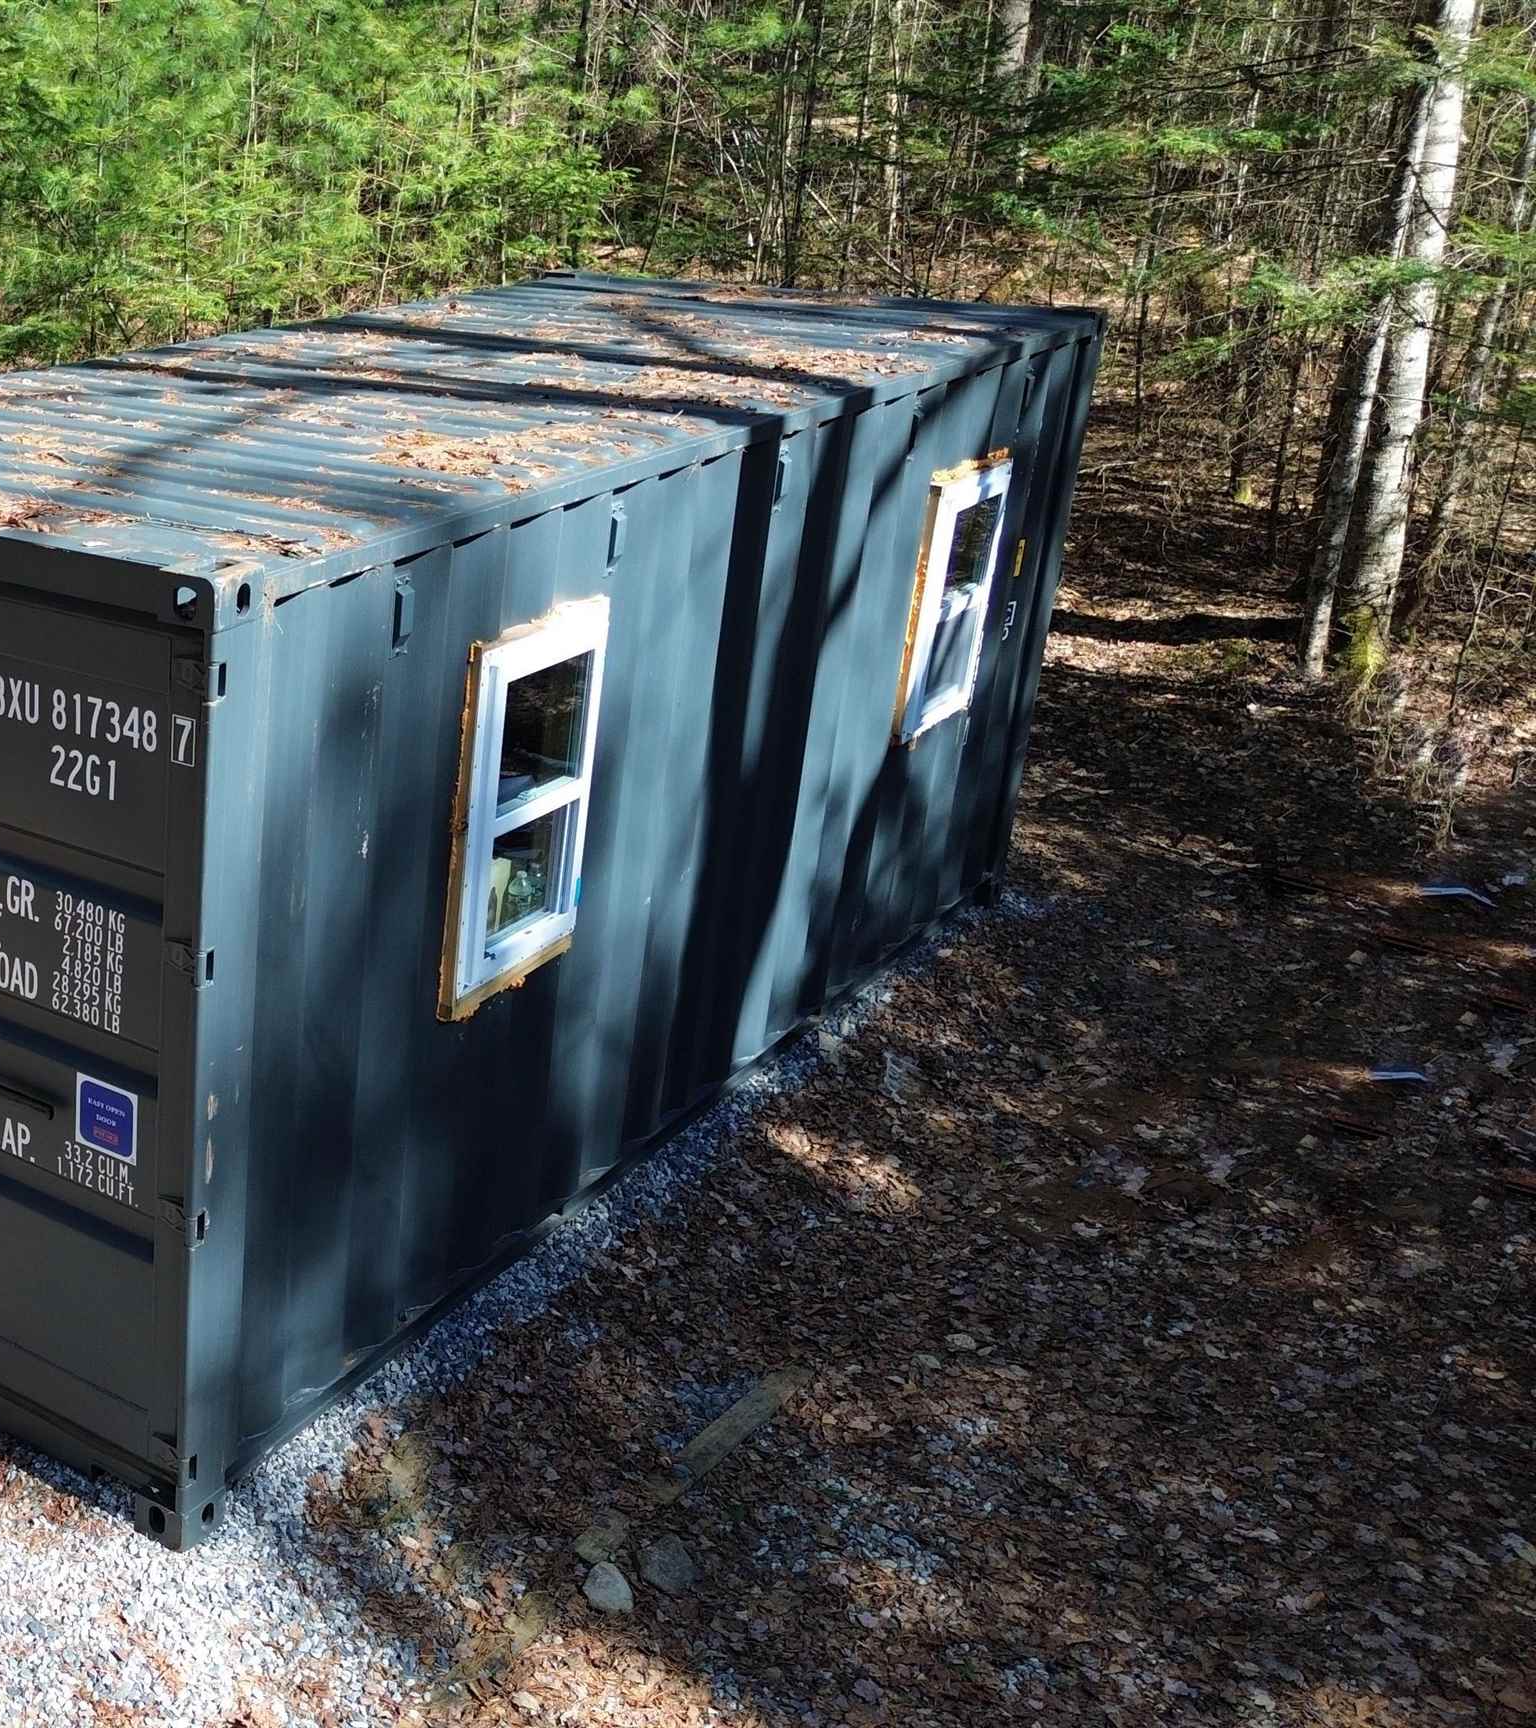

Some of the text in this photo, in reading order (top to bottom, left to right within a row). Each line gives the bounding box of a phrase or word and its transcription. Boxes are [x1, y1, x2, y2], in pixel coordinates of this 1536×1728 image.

[51, 688, 158, 753] 817348
[174, 717, 193, 762] 7
[49, 744, 116, 801] 22G1
[55, 890, 104, 926] 30.480
[108, 909, 126, 934] KG
[107, 930, 124, 954] LB
[106, 949, 124, 975] KG
[105, 967, 122, 994] LB
[104, 991, 122, 1015] KG
[104, 1011, 120, 1035] LB
[64, 1140, 93, 1169] 33.2
